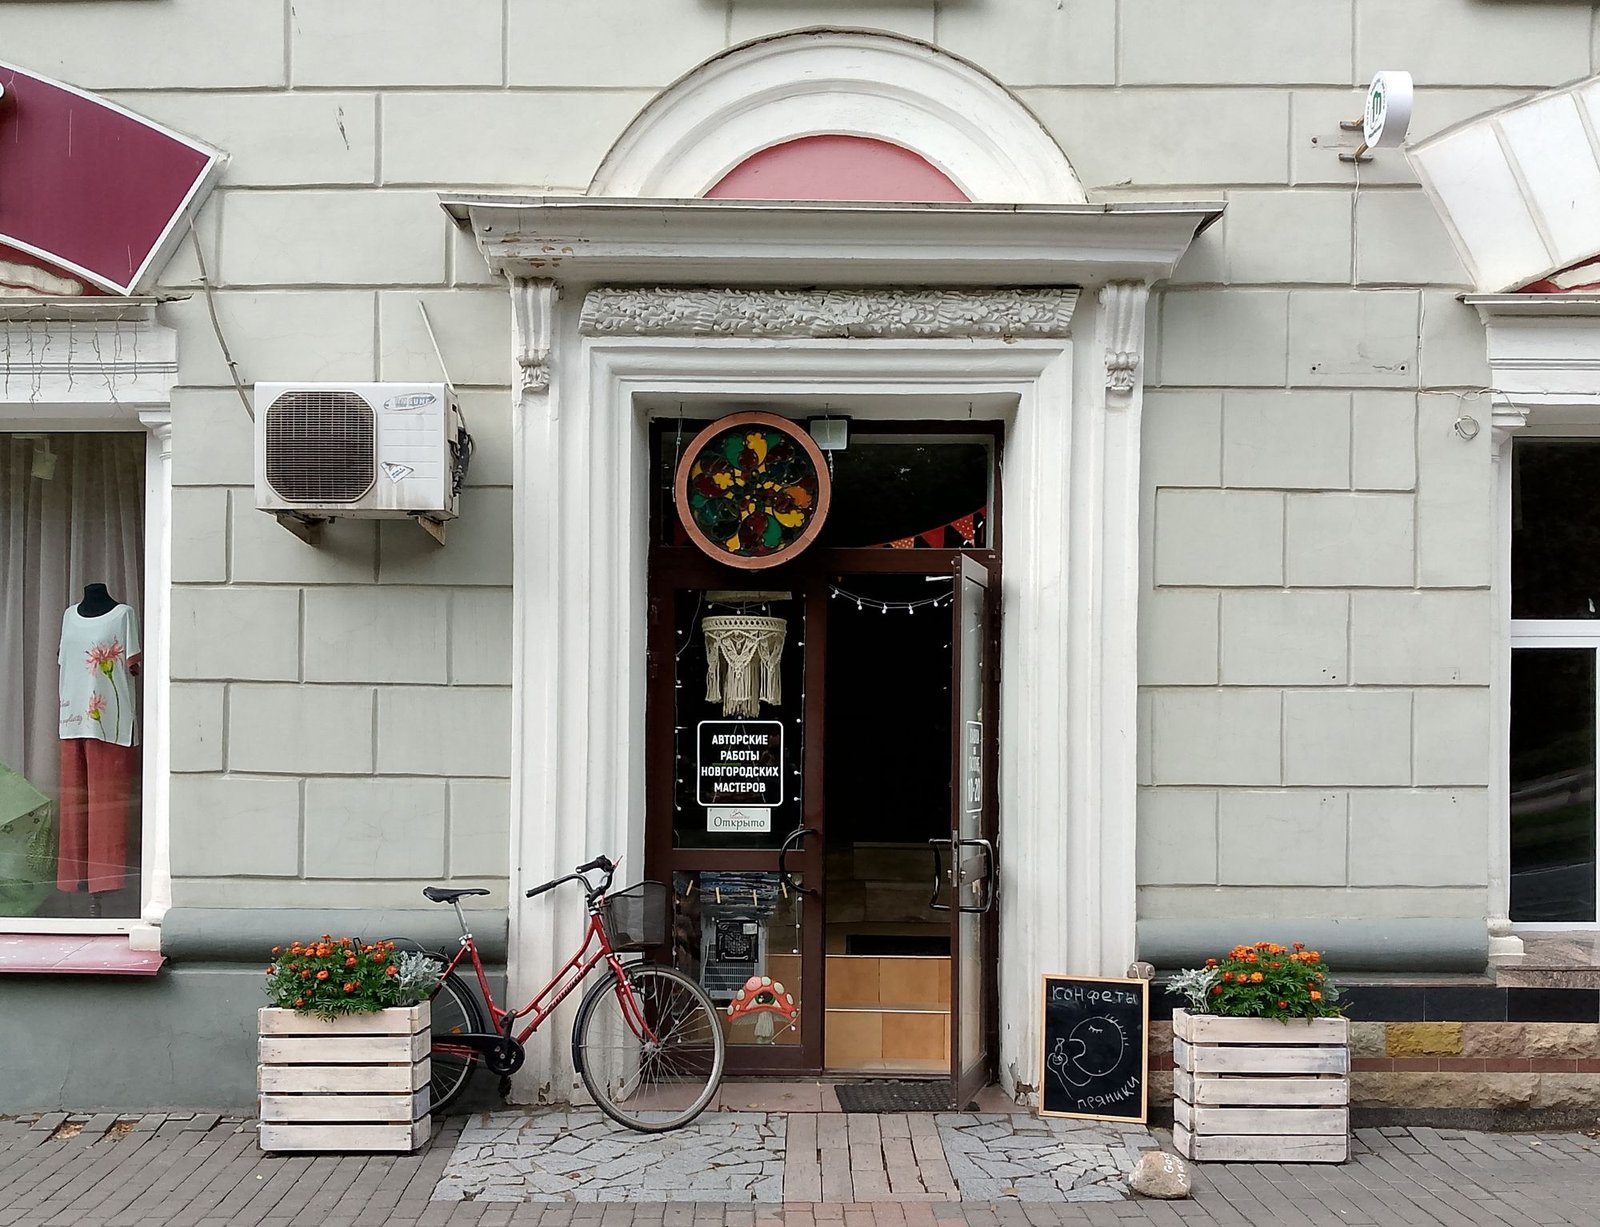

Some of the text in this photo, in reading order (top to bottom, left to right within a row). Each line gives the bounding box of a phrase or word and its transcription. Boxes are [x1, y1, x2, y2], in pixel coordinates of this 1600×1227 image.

[711, 734, 769, 745] АВТОРСКИЕ
[720, 750, 760, 761] РАБОТЫ
[701, 766, 779, 778] НОВГОРОДСКИХ
[714, 782, 766, 793] МАСТЕРОВ
[713, 816, 765, 830] Открыто
